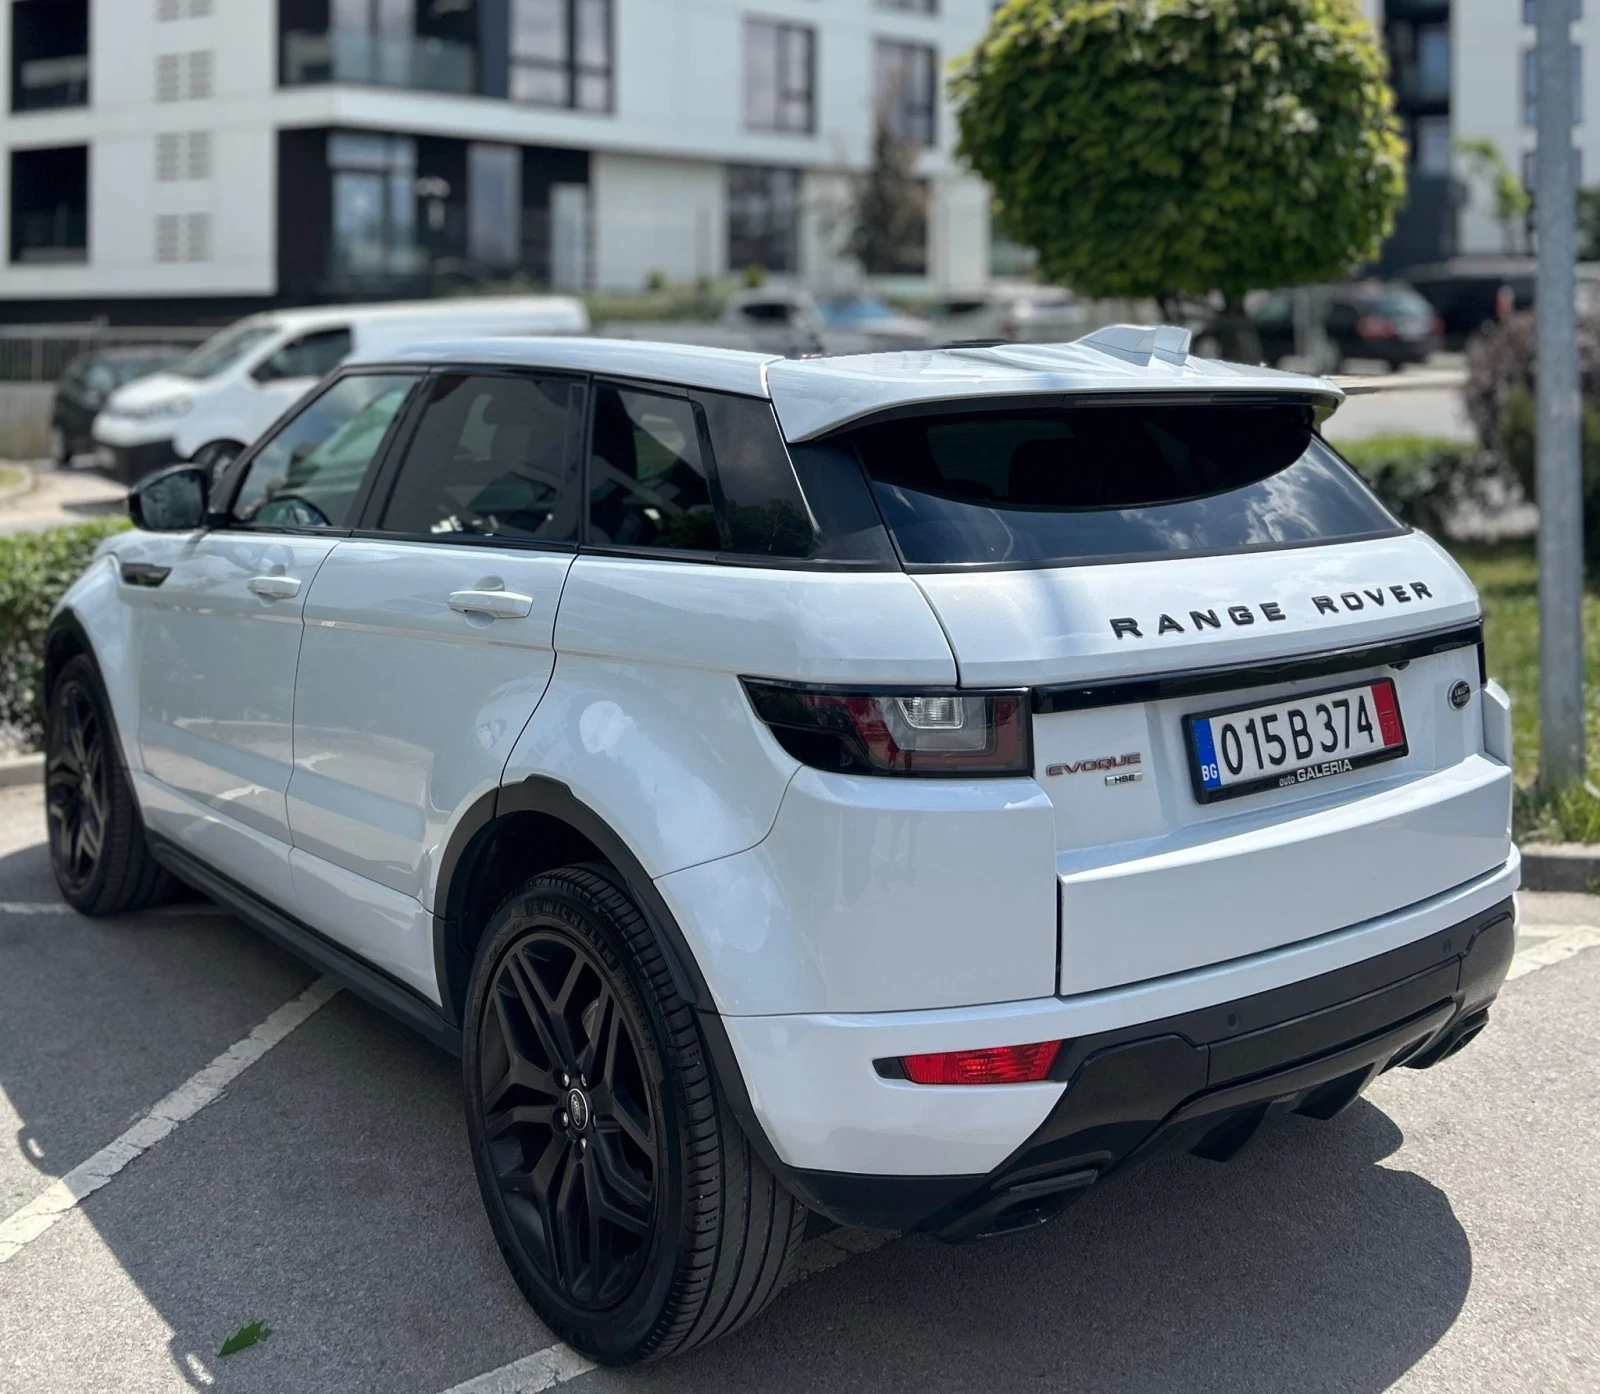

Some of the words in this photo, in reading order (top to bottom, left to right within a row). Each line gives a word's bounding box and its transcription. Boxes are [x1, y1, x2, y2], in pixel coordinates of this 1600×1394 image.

[1109, 602, 1287, 640] RANGE
[1311, 581, 1433, 615] ROVER
[1045, 751, 1142, 777] EVOQUE
[1202, 764, 1218, 782] BG
[1279, 774, 1296, 788] auto
[1296, 759, 1353, 783] GALERIA
[1114, 773, 1135, 784] HSE
[541, 900, 617, 966] MICHELIN
